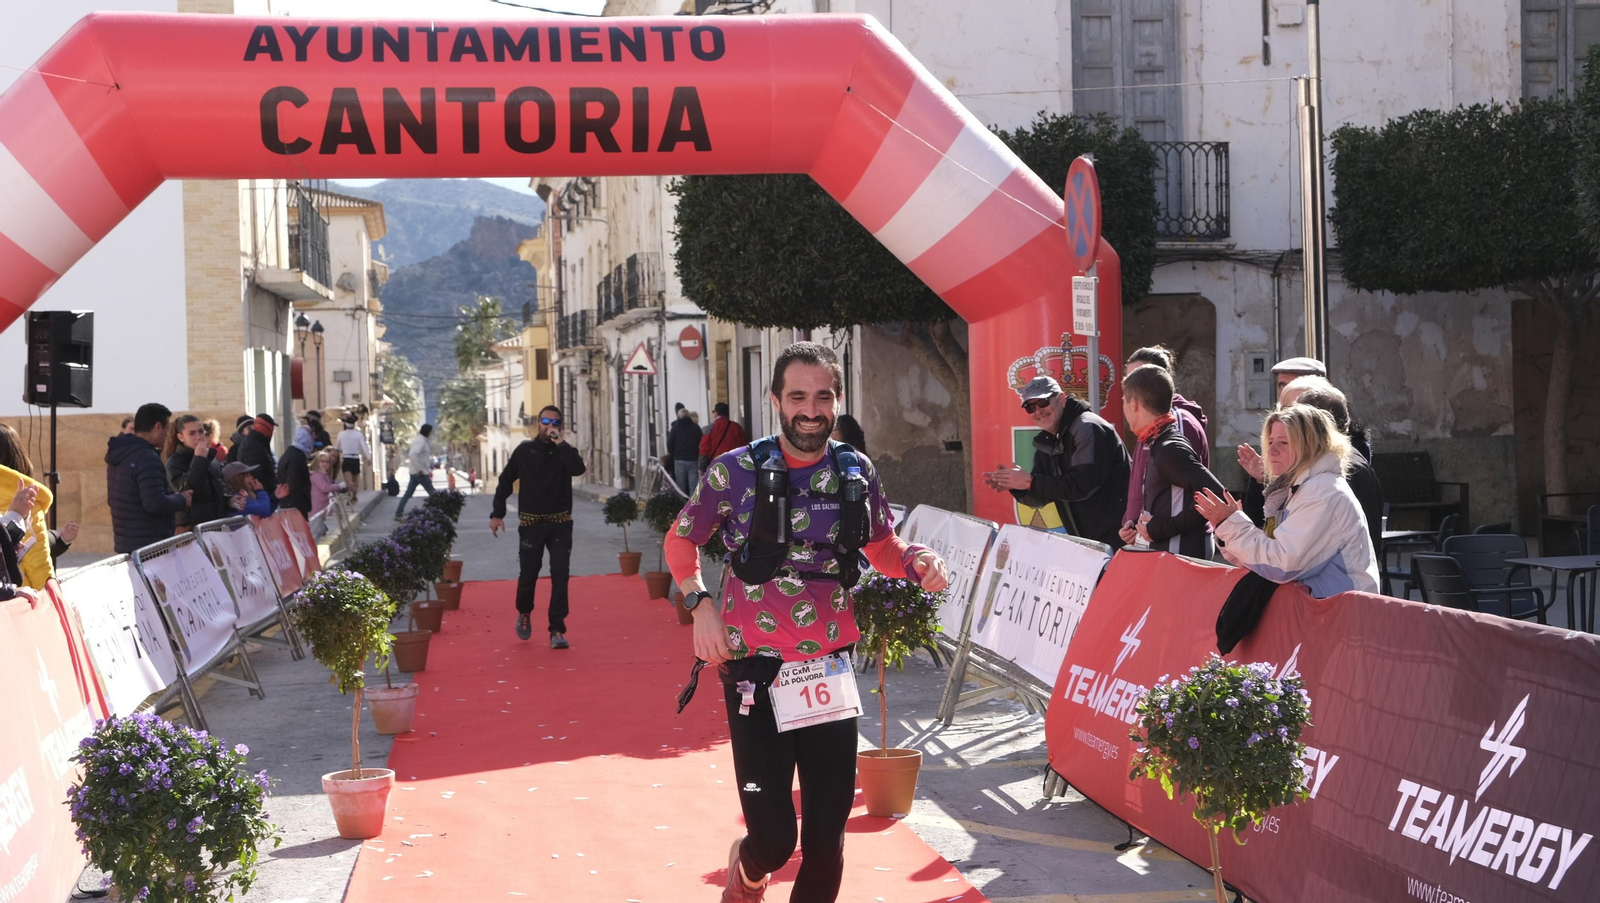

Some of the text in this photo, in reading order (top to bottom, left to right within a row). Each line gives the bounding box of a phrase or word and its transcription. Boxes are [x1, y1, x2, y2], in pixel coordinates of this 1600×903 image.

[244, 25, 725, 62] AYUNTAMIENTO
[259, 86, 712, 155] CANTORIA
[965, 552, 977, 571] DE
[1008, 559, 1088, 606] AYUNTAMIENTO DE
[97, 619, 162, 680] CANTRIA
[781, 670, 790, 678] IV
[792, 666, 811, 676] CxM
[799, 682, 831, 709] 16
[1064, 664, 1147, 727] TEAMERG
[1074, 727, 1119, 760] www.teamergy.es
[1388, 778, 1594, 890] TEAMERGY
